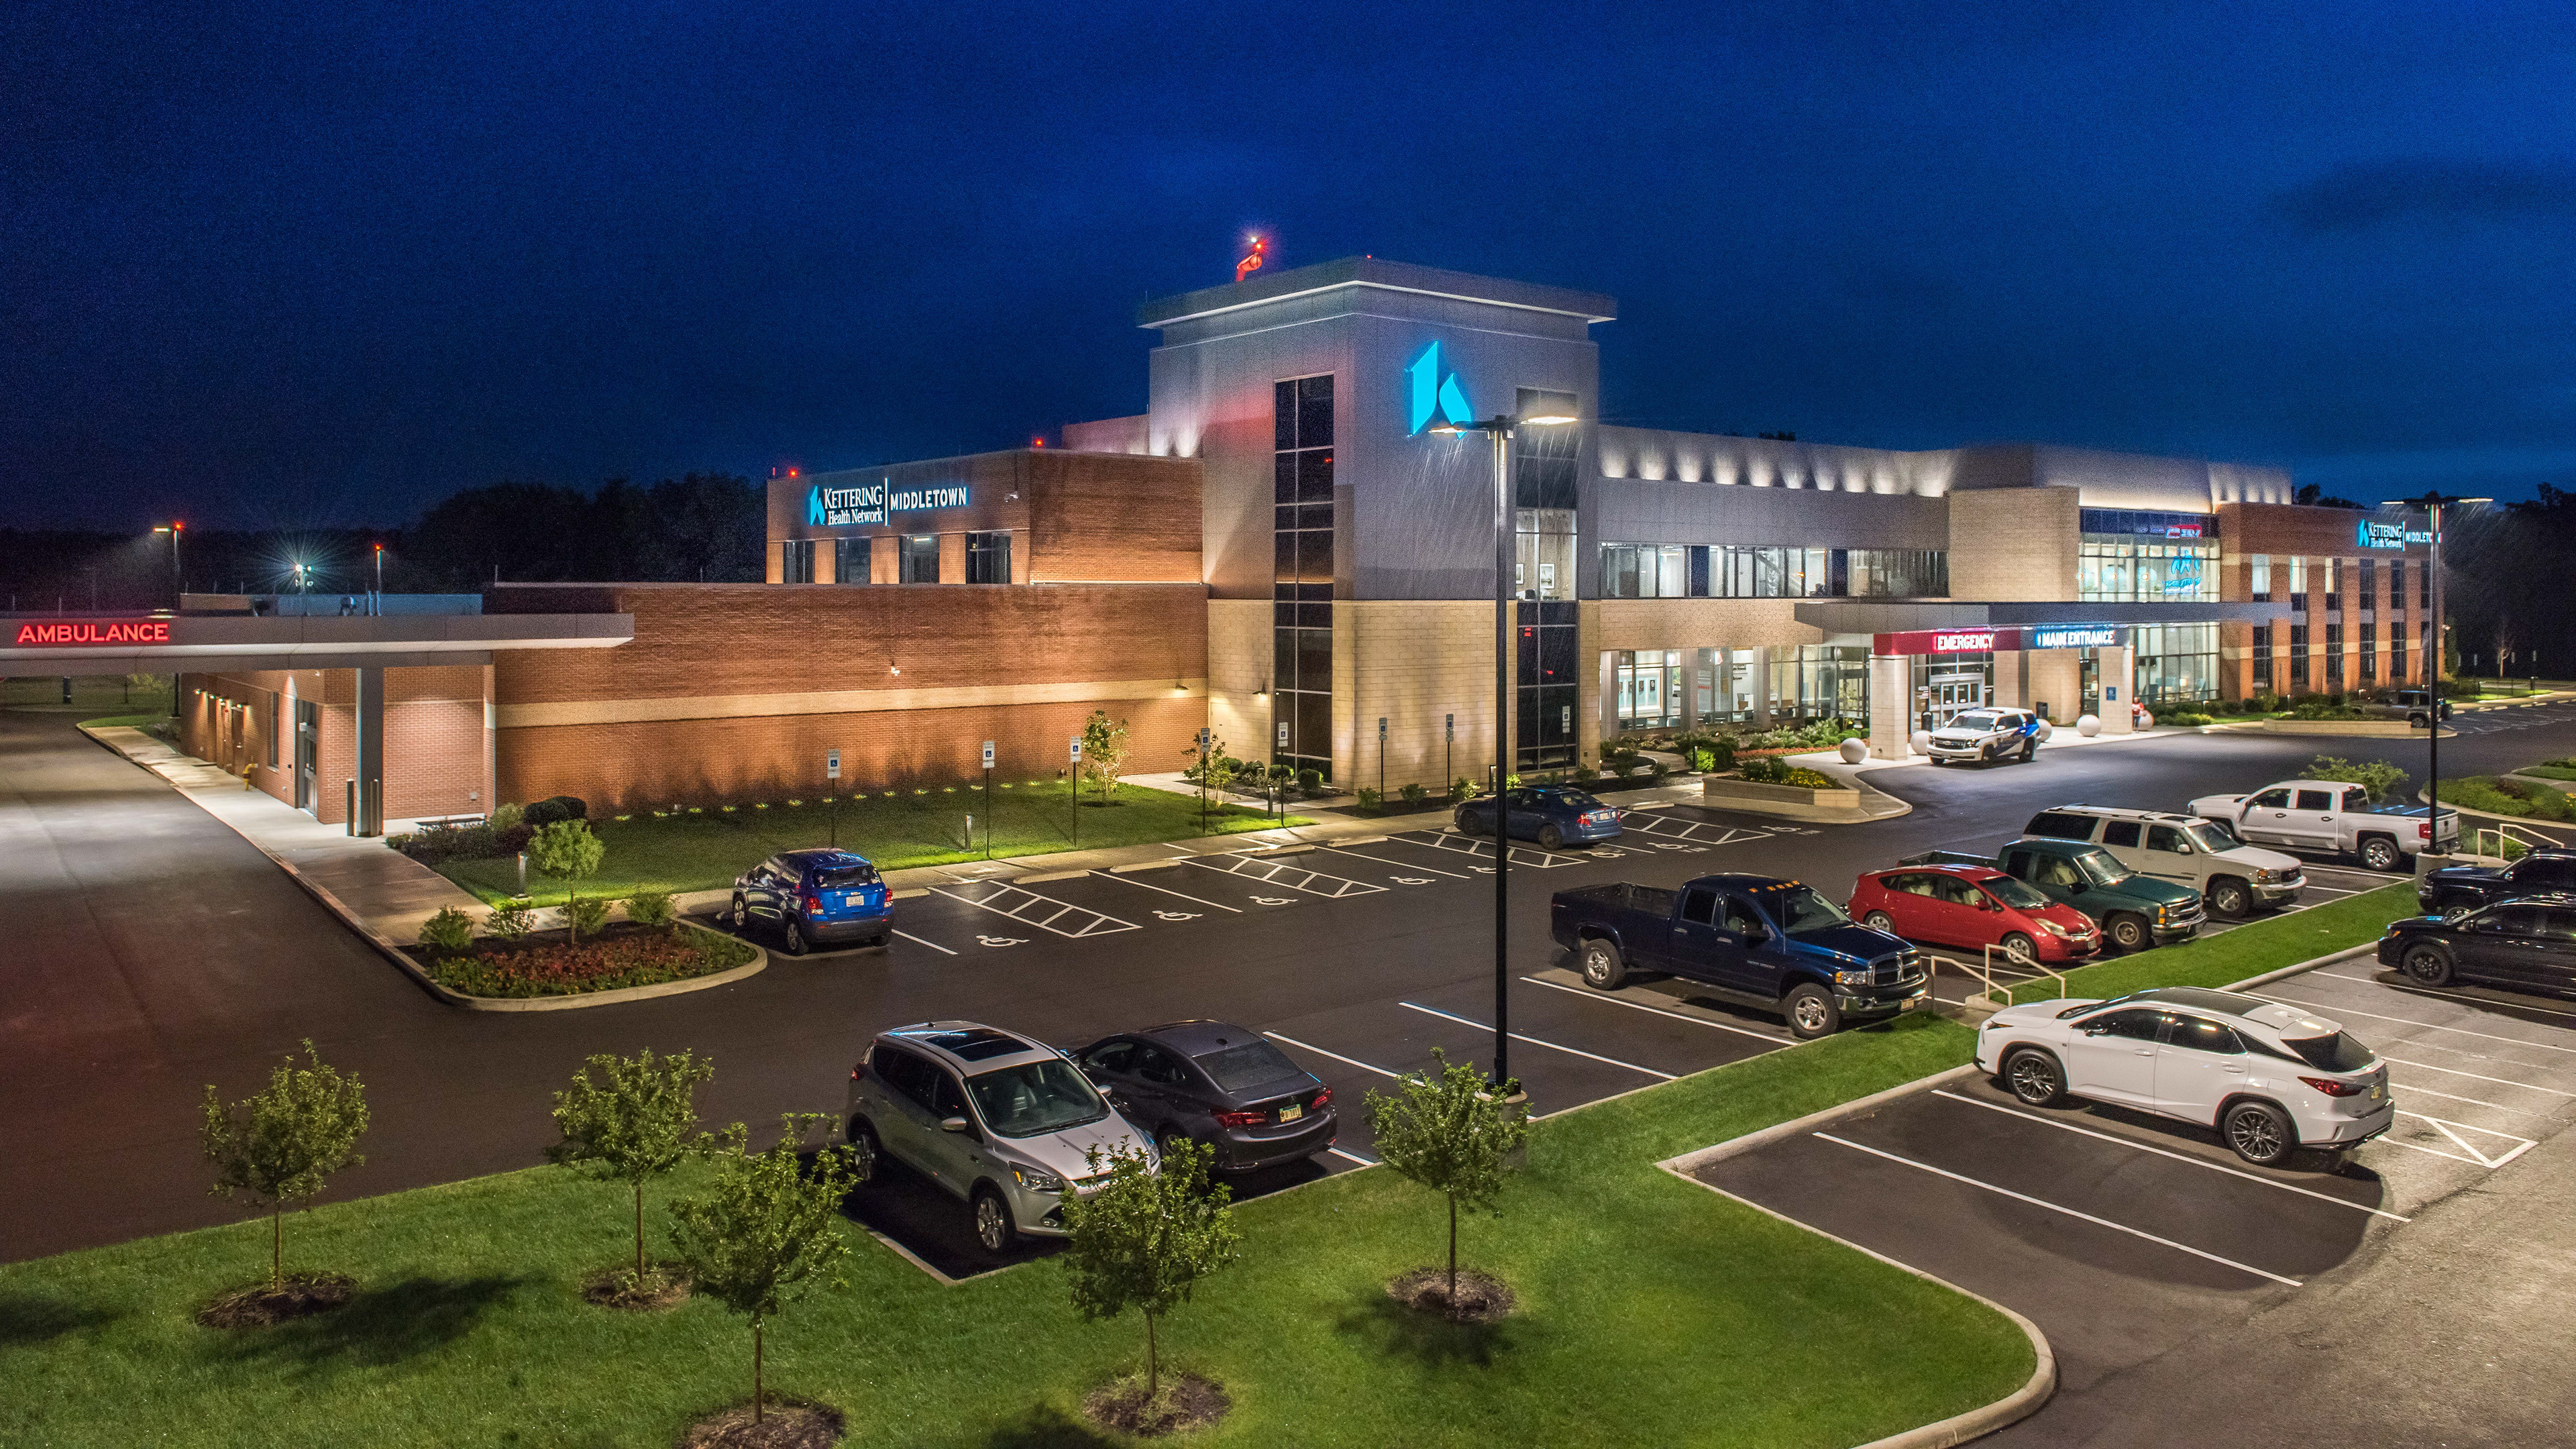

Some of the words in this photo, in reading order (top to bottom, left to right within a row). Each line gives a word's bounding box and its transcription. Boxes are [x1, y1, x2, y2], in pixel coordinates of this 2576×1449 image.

[824, 486, 883, 509] KETTERING
[890, 487, 967, 510] MIDDLETOWN
[828, 510, 851, 525] Health
[851, 508, 883, 524] Network
[17, 623, 169, 643] AMBULANCE
[1937, 633, 1994, 650] EMERGENCY
[2043, 632, 2068, 647] MAIN
[2068, 630, 2115, 646] ENTRANCE
